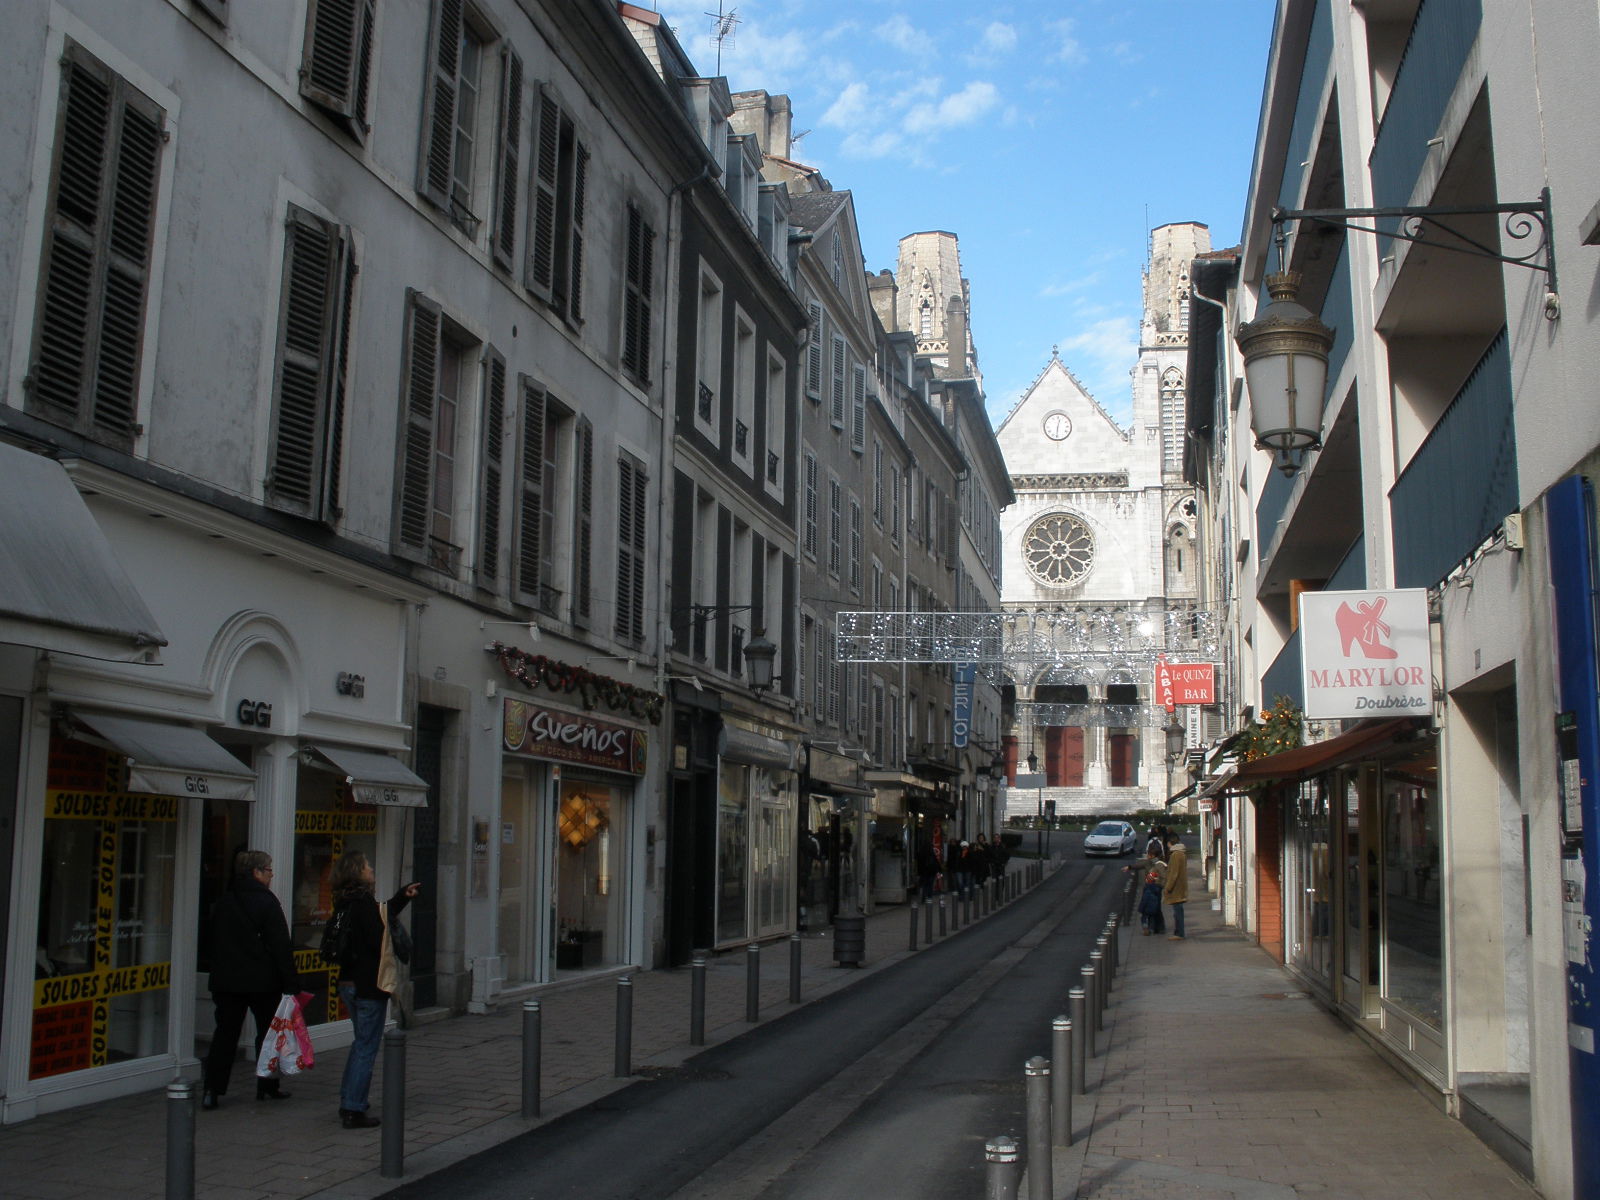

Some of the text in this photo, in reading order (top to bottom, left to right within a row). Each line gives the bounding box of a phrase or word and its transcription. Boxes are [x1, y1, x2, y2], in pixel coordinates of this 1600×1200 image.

[1160, 660, 1174, 706] TABAC
[1310, 666, 1425, 689] MARYLOR
[1185, 688, 1208, 700] BAR
[1355, 695, 1427, 710] Doubrère
[54, 793, 110, 815] SOLDES
[114, 794, 148, 818] SALE
[295, 813, 329, 831] SOLDES
[330, 814, 352, 832] SALE
[98, 907, 112, 965] SALE
[41, 976, 98, 1005] SOLDES
[103, 969, 137, 995] SALE
